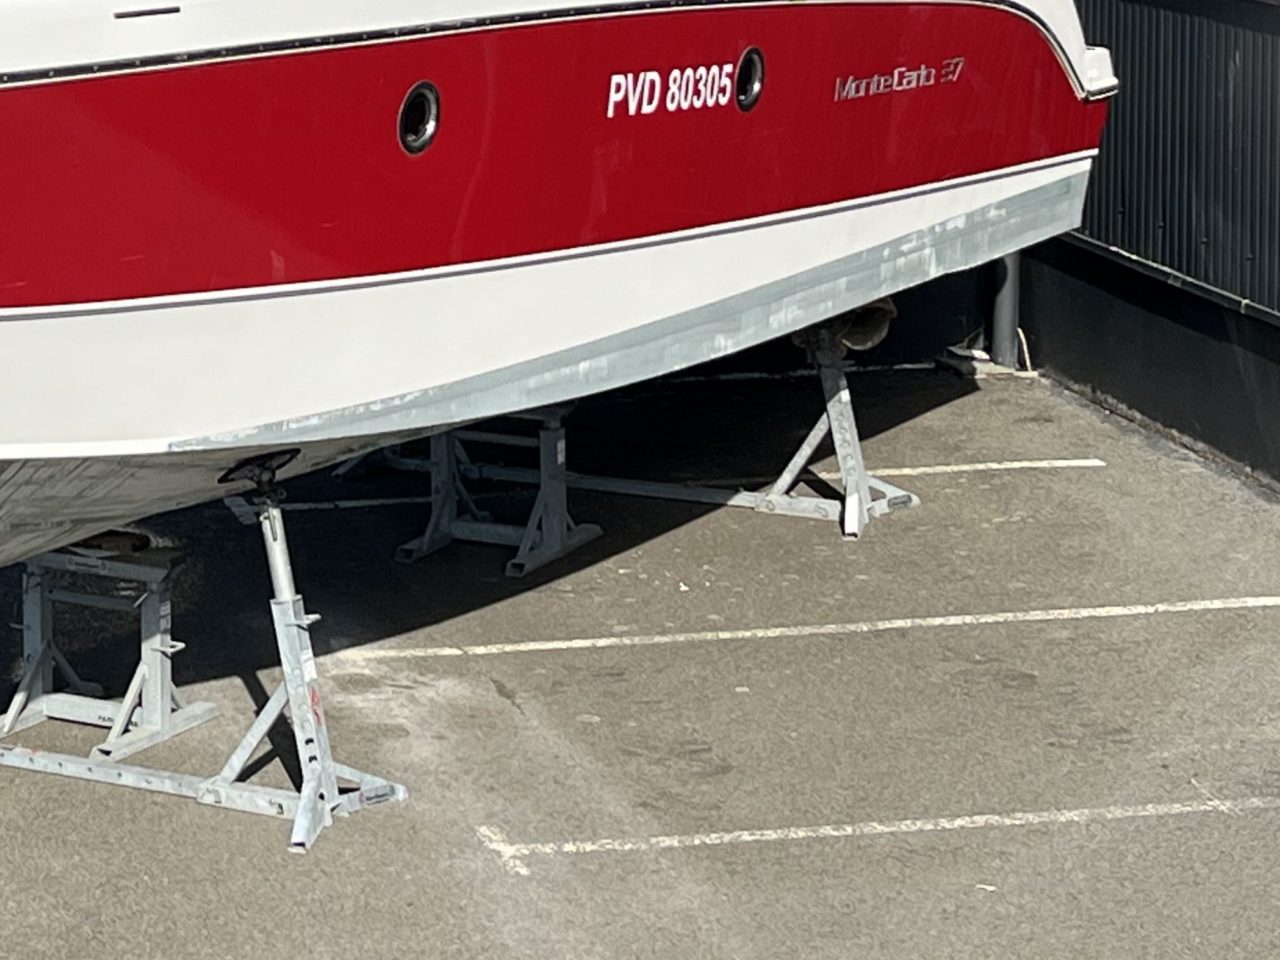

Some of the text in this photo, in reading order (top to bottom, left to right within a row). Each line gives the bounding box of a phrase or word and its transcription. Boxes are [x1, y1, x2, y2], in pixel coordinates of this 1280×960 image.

[940, 56, 965, 82] 37
[607, 63, 733, 118] PVD 80305
